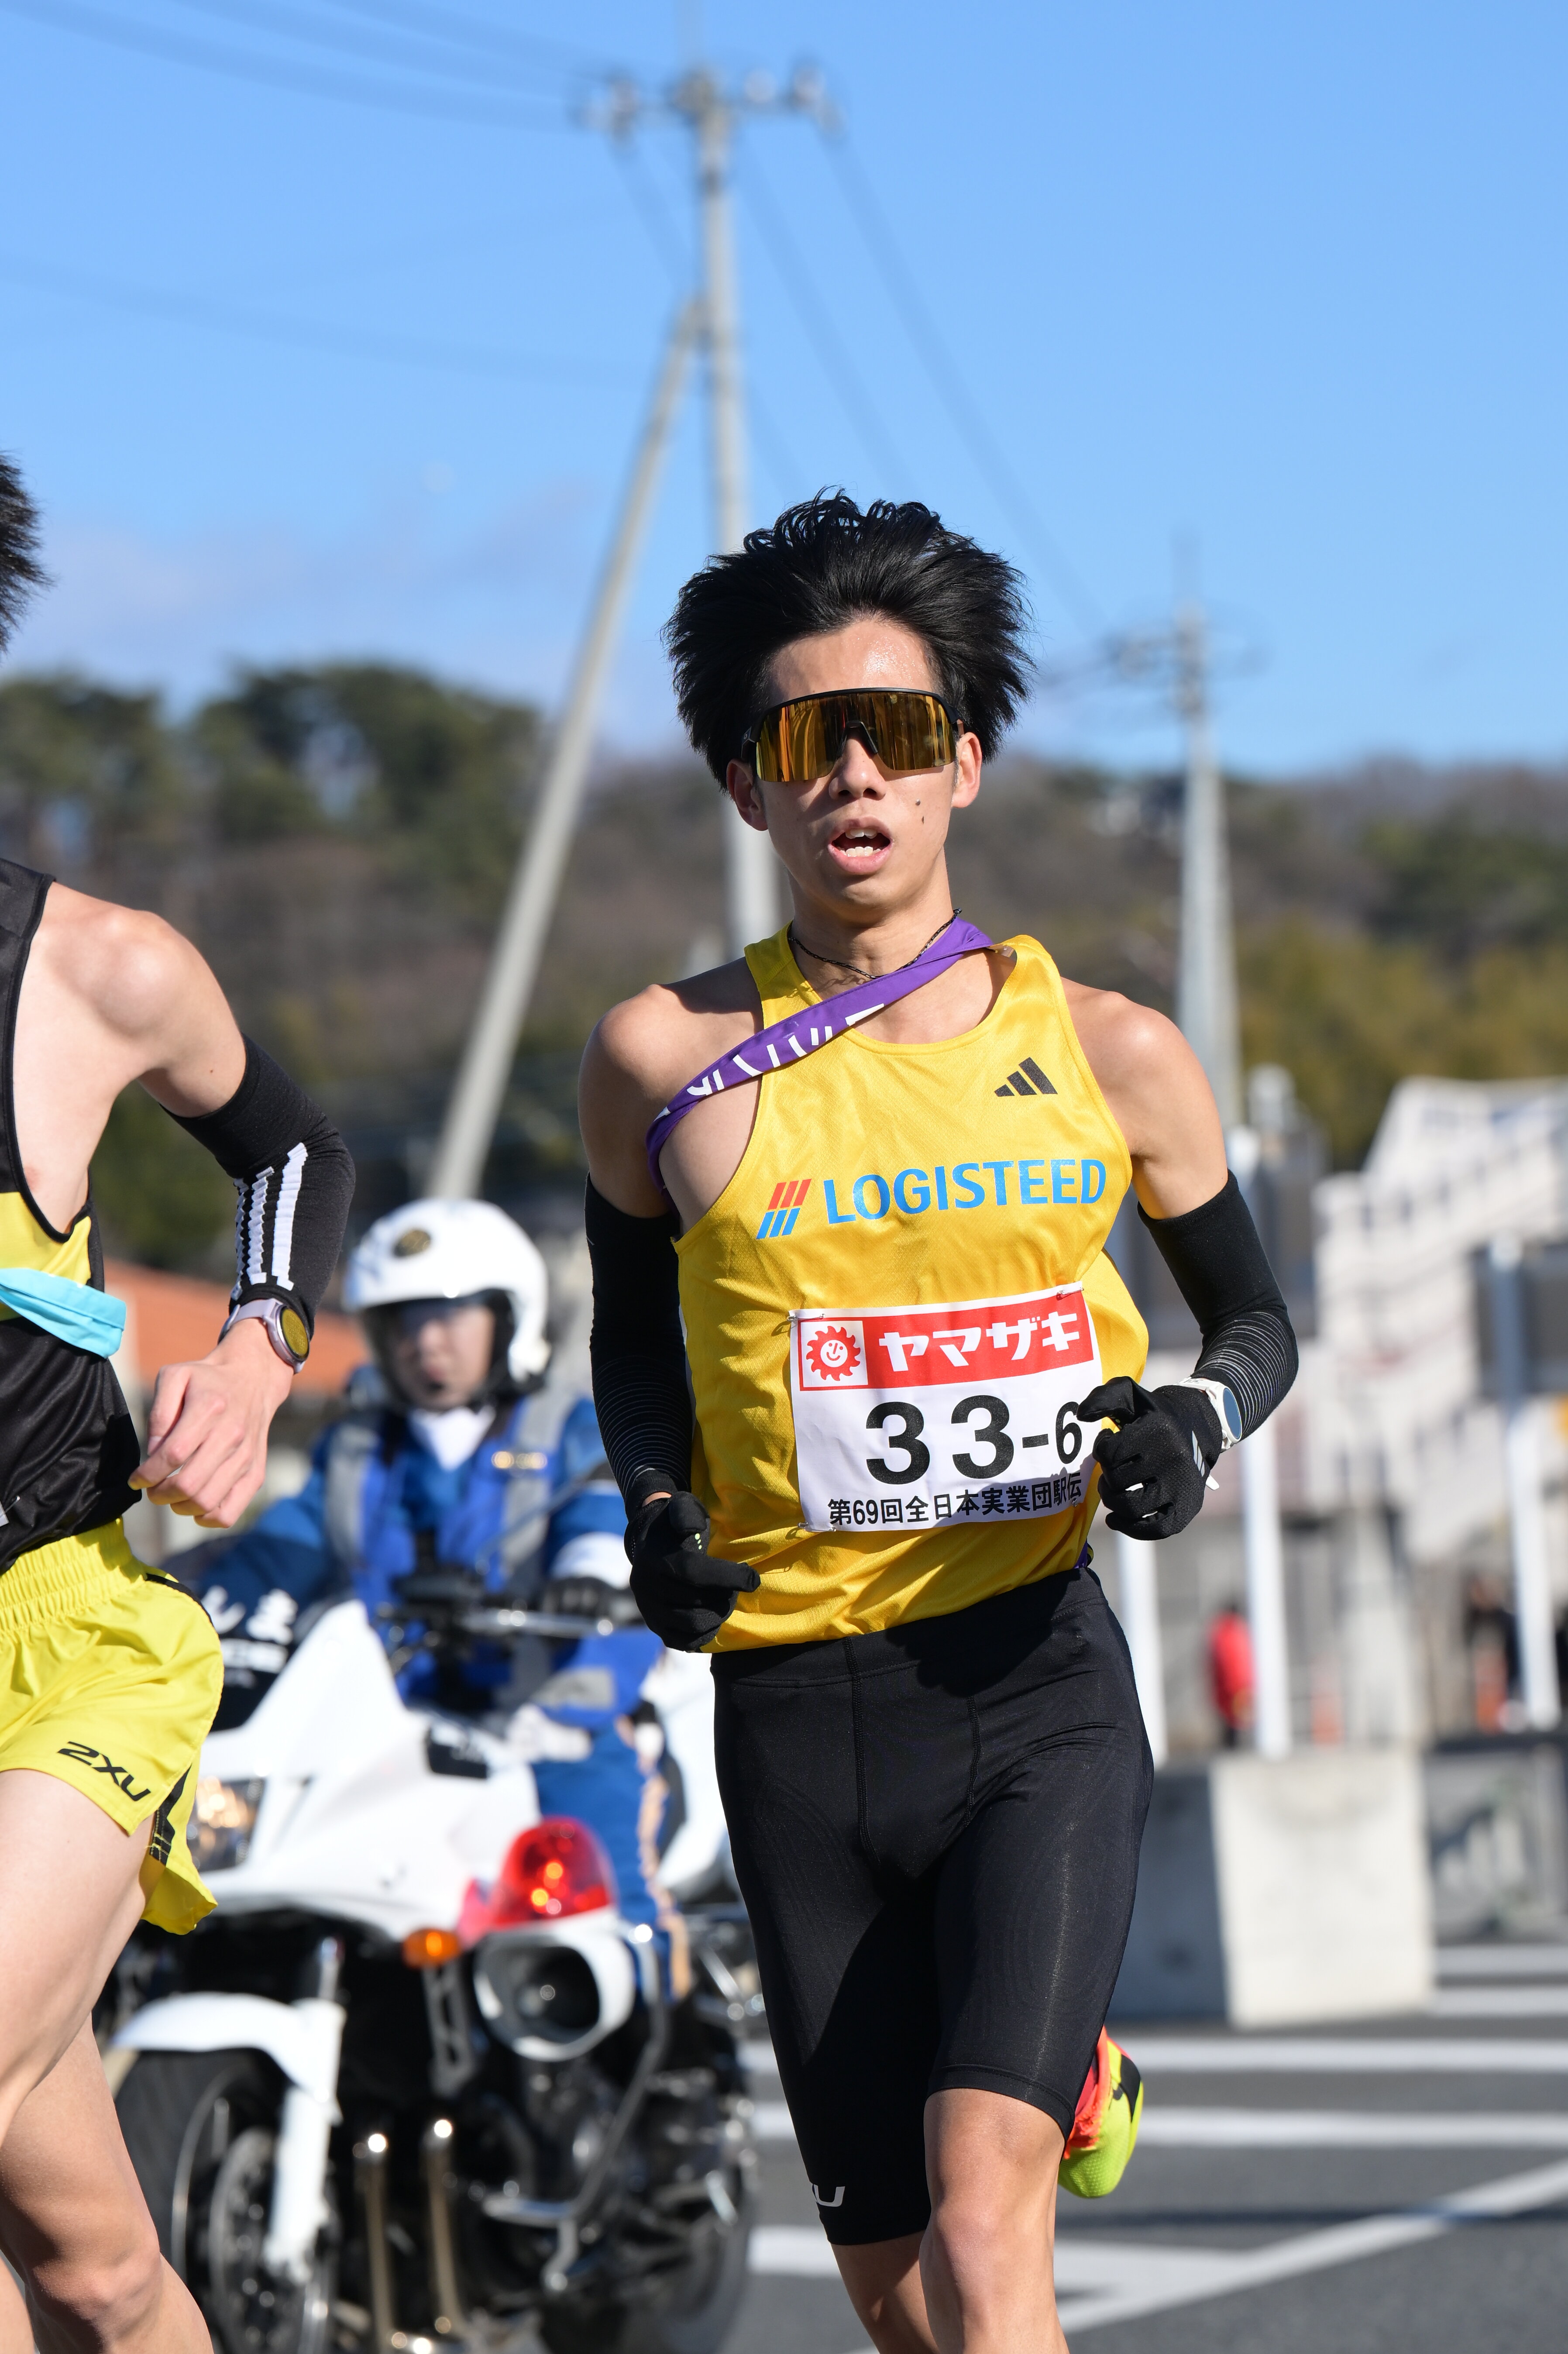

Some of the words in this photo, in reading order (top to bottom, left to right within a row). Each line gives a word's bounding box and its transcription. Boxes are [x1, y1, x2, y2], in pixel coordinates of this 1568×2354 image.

[823, 1159, 1106, 1224] LOGISTEED
[879, 1311, 1080, 1372] ヤマザキ
[828, 1472, 1083, 1526] 第69回全日本実業団駅伝
[58, 1741, 151, 1801] 2XU
